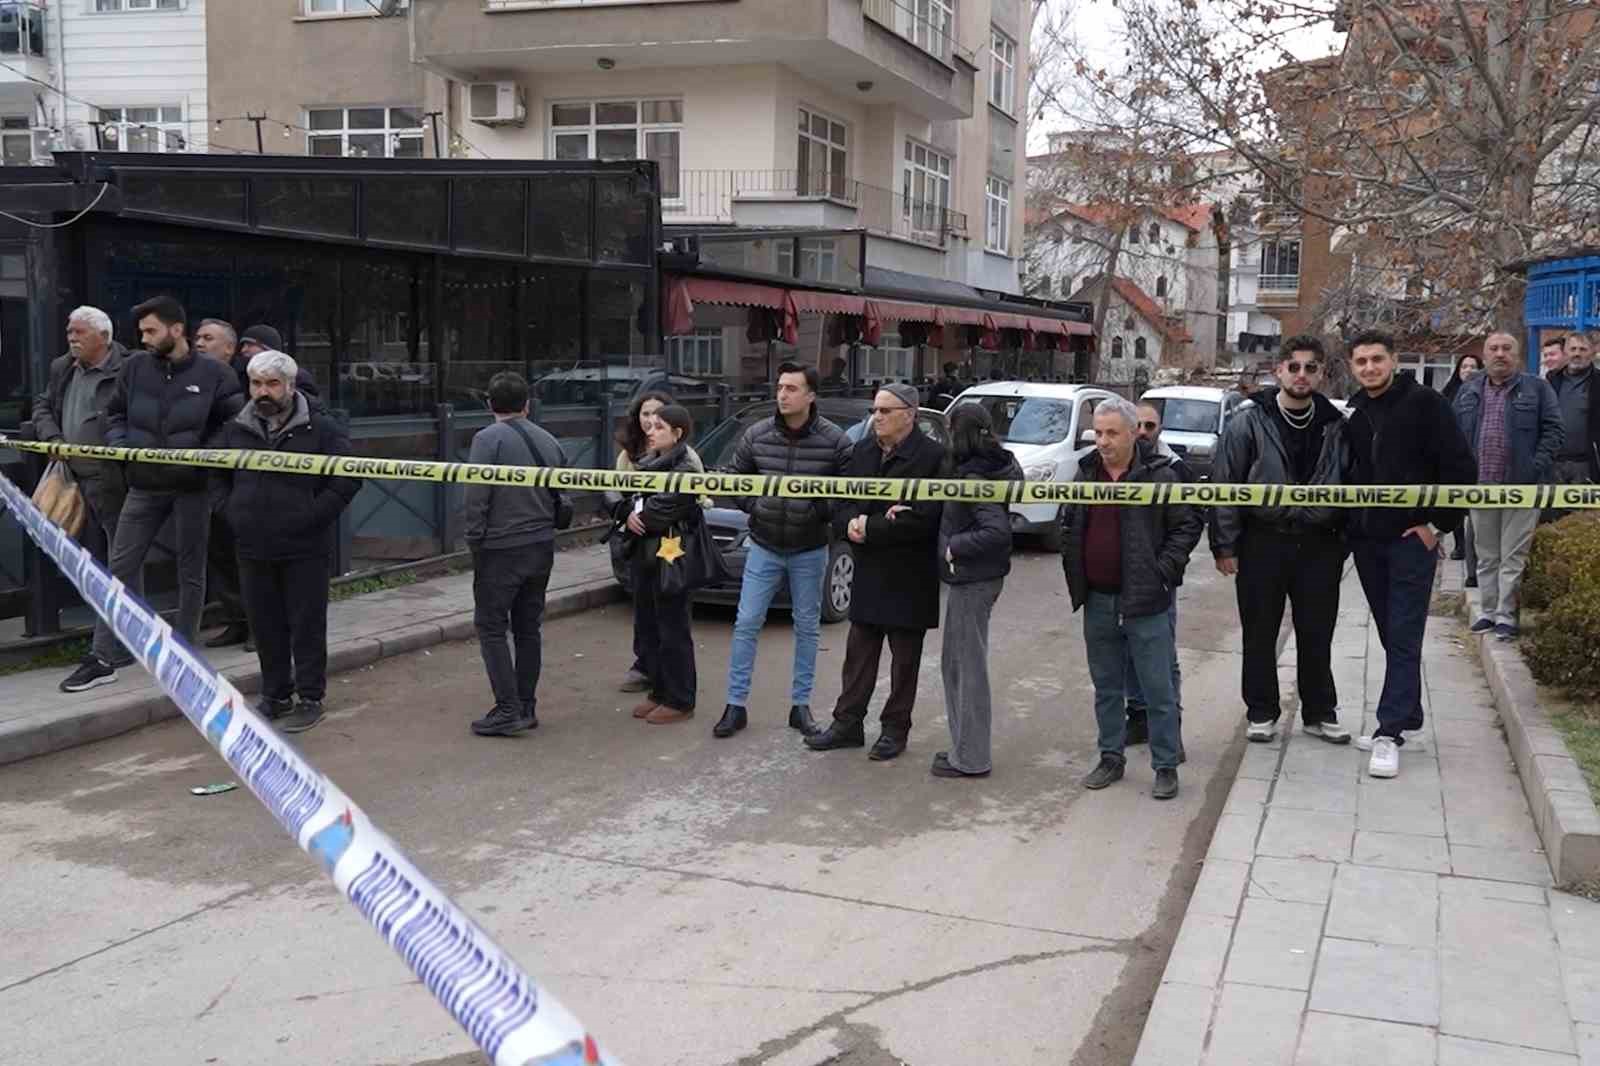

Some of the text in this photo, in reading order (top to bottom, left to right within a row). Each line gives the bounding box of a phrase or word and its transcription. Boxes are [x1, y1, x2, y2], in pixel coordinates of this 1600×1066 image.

[342, 459, 435, 478] GİRİLMEZ
[466, 466, 526, 482] POLİS
[557, 470, 656, 489] GİRİLMEZ
[690, 476, 754, 492] POLİS
[787, 479, 892, 496] GİRİLMEZ
[928, 482, 995, 497] POLİS
[1031, 484, 1143, 501] GİRİLMEZ
[1181, 486, 1252, 502] POLİS
[1290, 487, 1408, 504] GİRİLMEZ
[1448, 488, 1523, 504] POLİS
